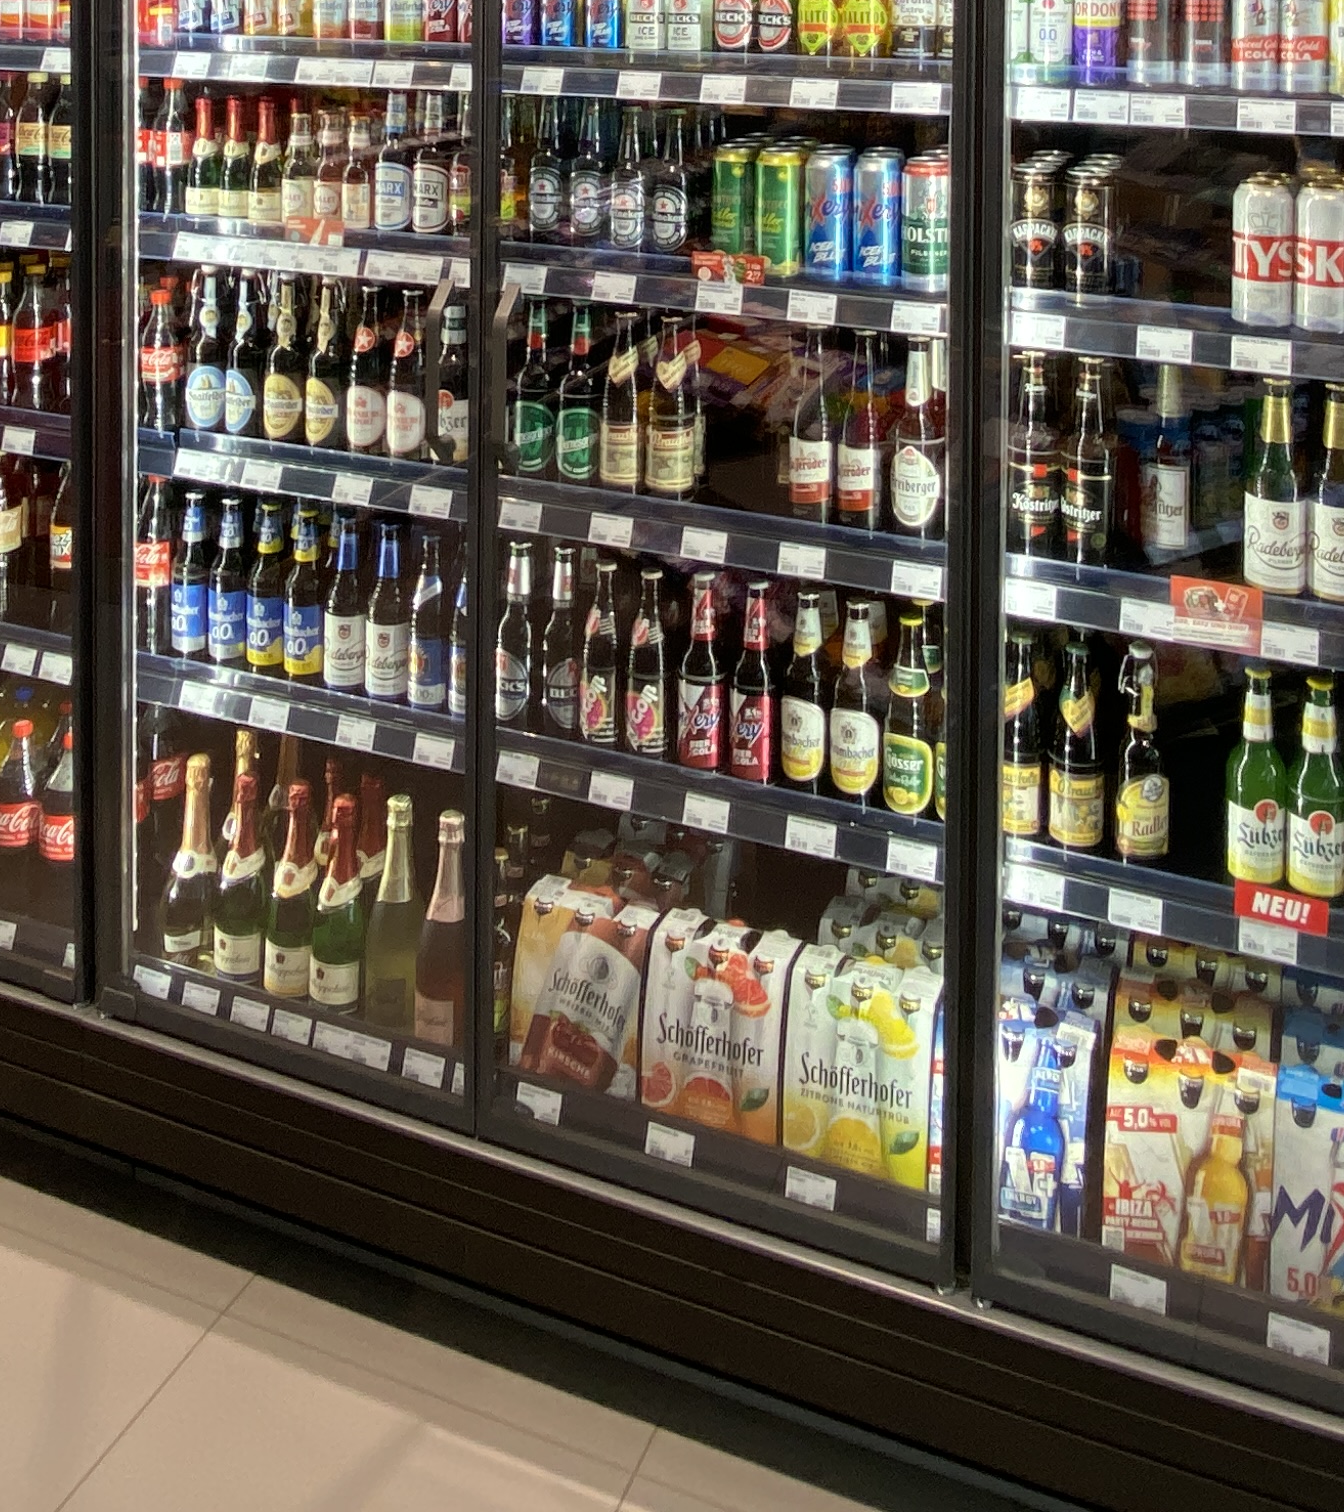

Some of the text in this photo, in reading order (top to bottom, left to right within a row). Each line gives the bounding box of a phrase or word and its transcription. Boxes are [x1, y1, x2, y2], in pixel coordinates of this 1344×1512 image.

[1074, 2, 1120, 17] ORDON
[638, 27, 655, 36] ICE
[673, 27, 688, 36] ICE
[1280, 52, 1312, 61] COLA
[439, 412, 467, 431] bzer
[1251, 891, 1312, 925] NEU!
[657, 1012, 765, 1068] Schöfferhofer
[673, 1050, 745, 1080] GRAPEFRUIT
[799, 1051, 914, 1111] Schöfferhofer
[800, 1088, 911, 1126] ZITRONE NATURTRÜB
[1115, 1200, 1154, 1218] IBIZA
